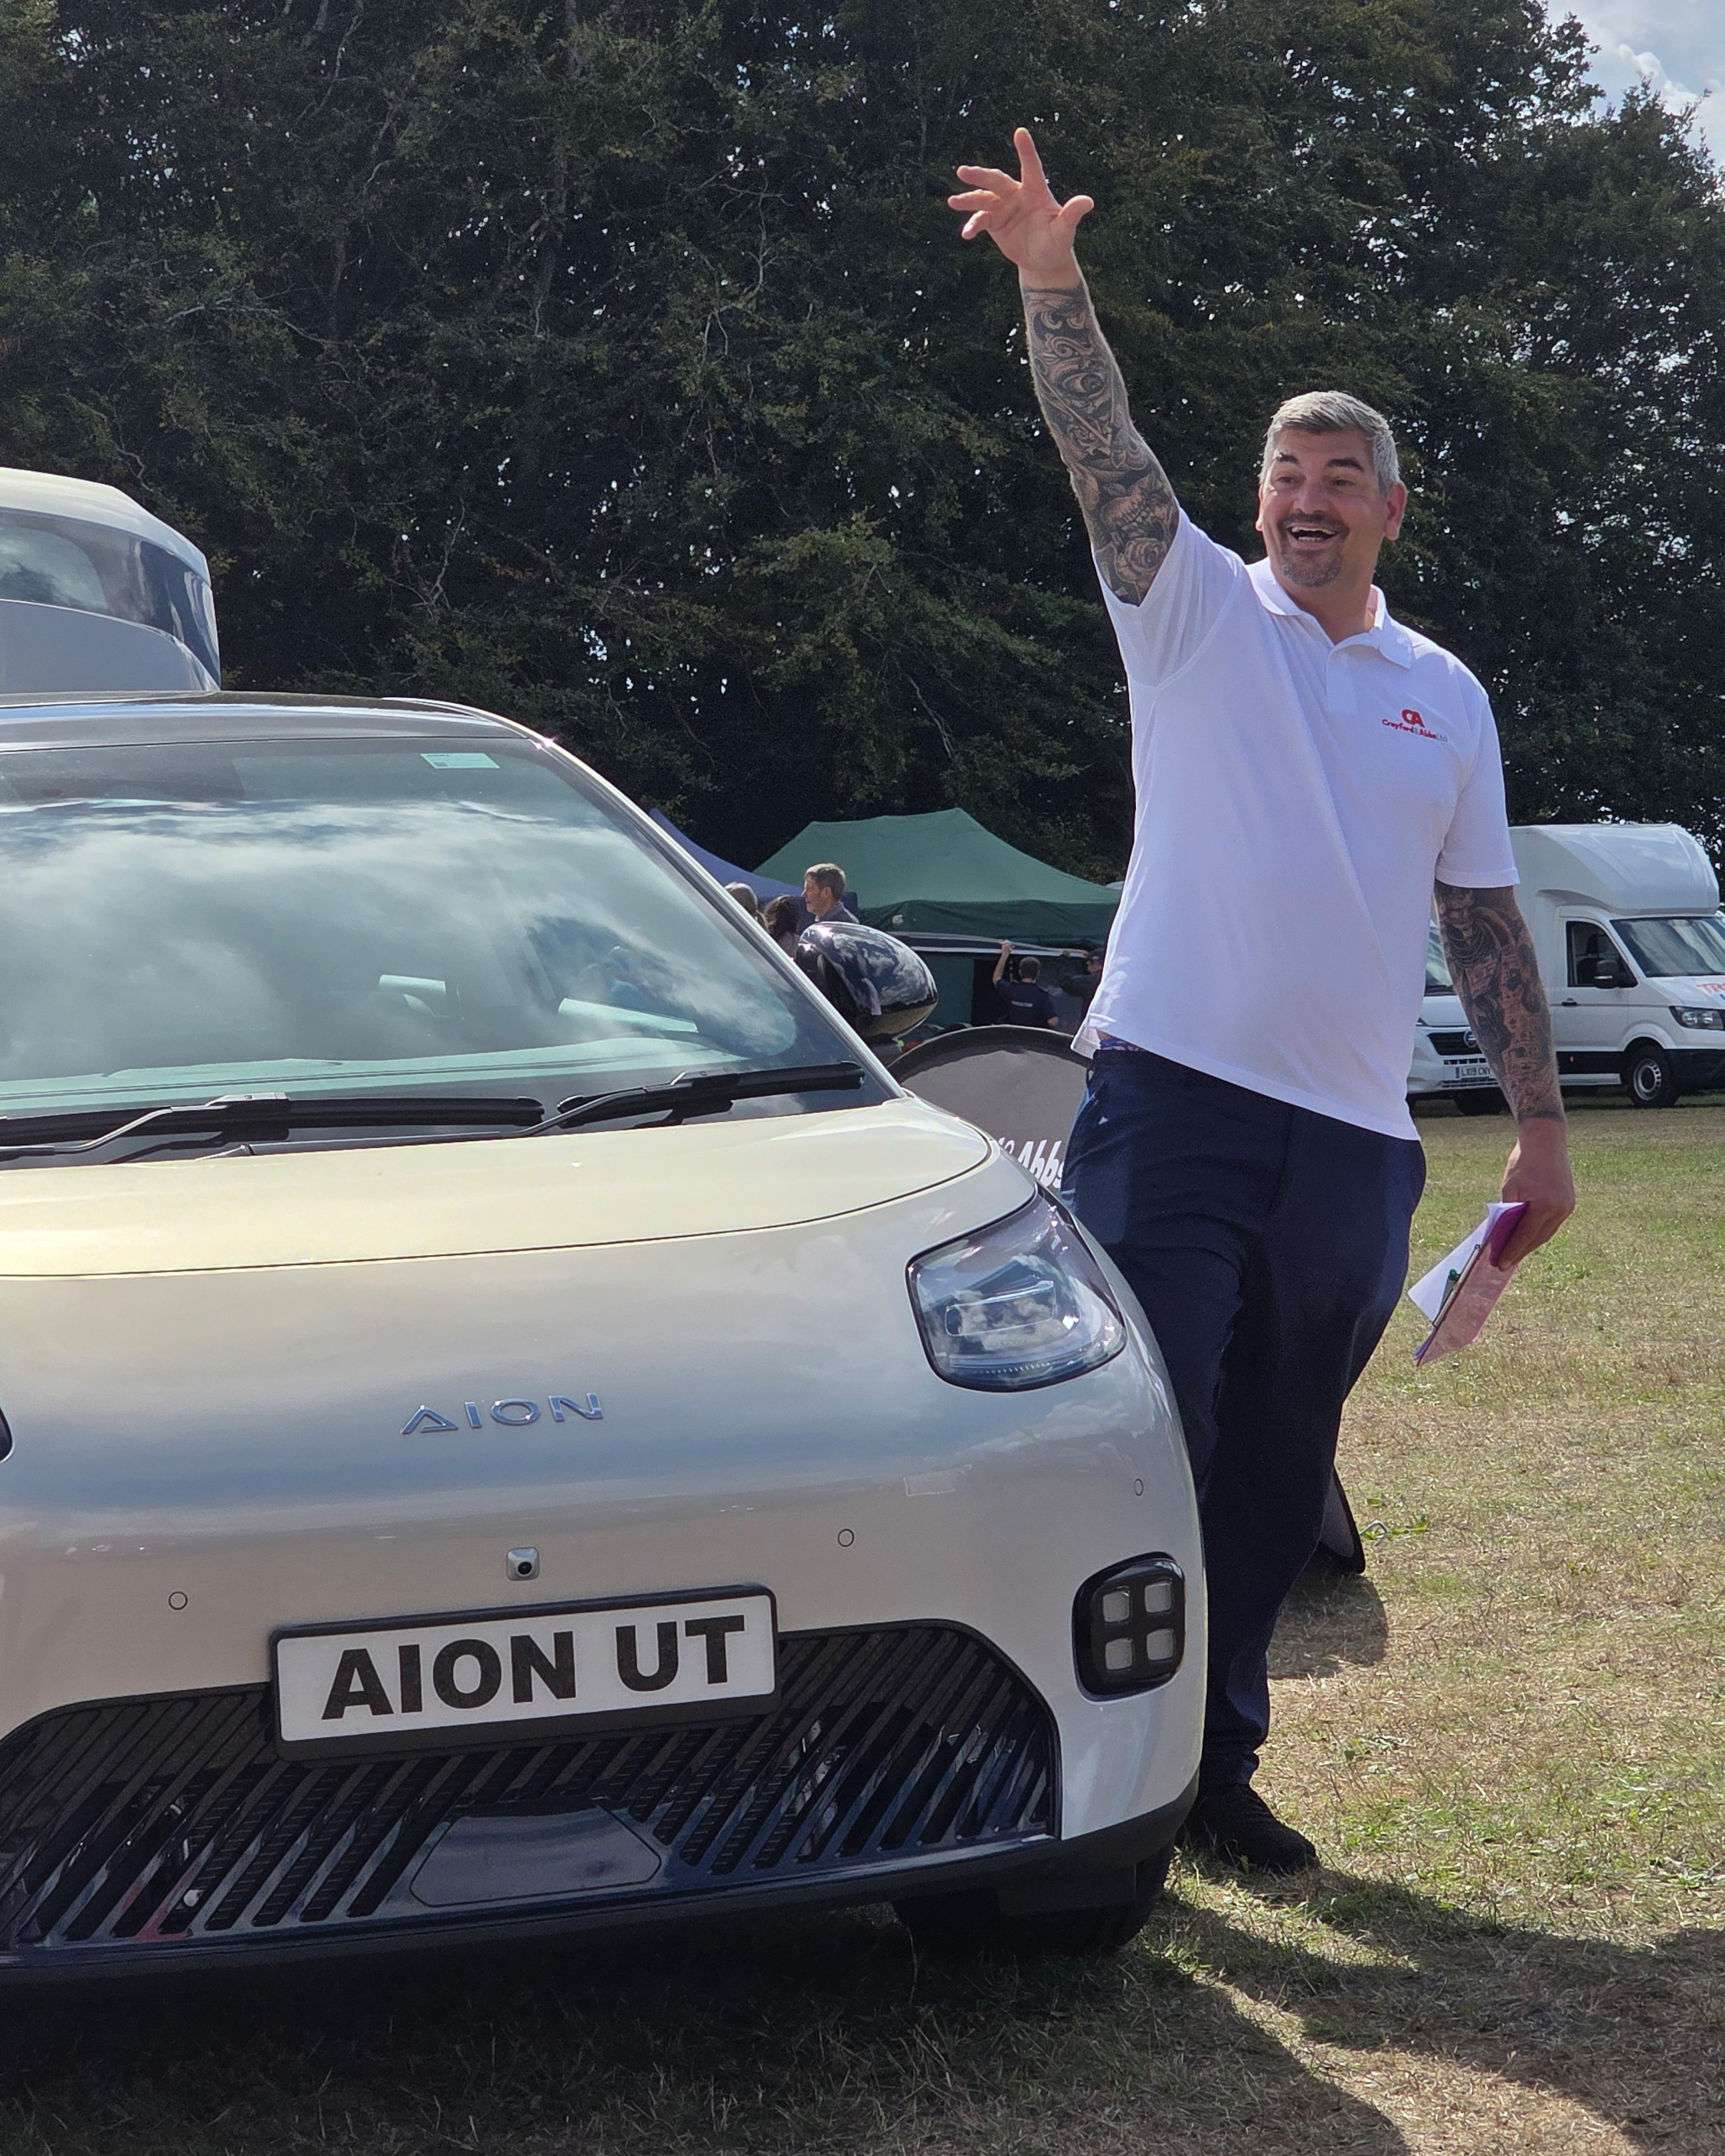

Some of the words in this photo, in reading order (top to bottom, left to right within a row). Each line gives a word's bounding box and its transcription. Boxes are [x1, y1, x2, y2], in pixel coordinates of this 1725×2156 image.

[1381, 718, 1414, 734] Crayford
[1402, 708, 1425, 728] CA
[400, 1392, 604, 1435] AION
[321, 1631, 576, 1719] AION
[615, 1615, 745, 1692] UT
